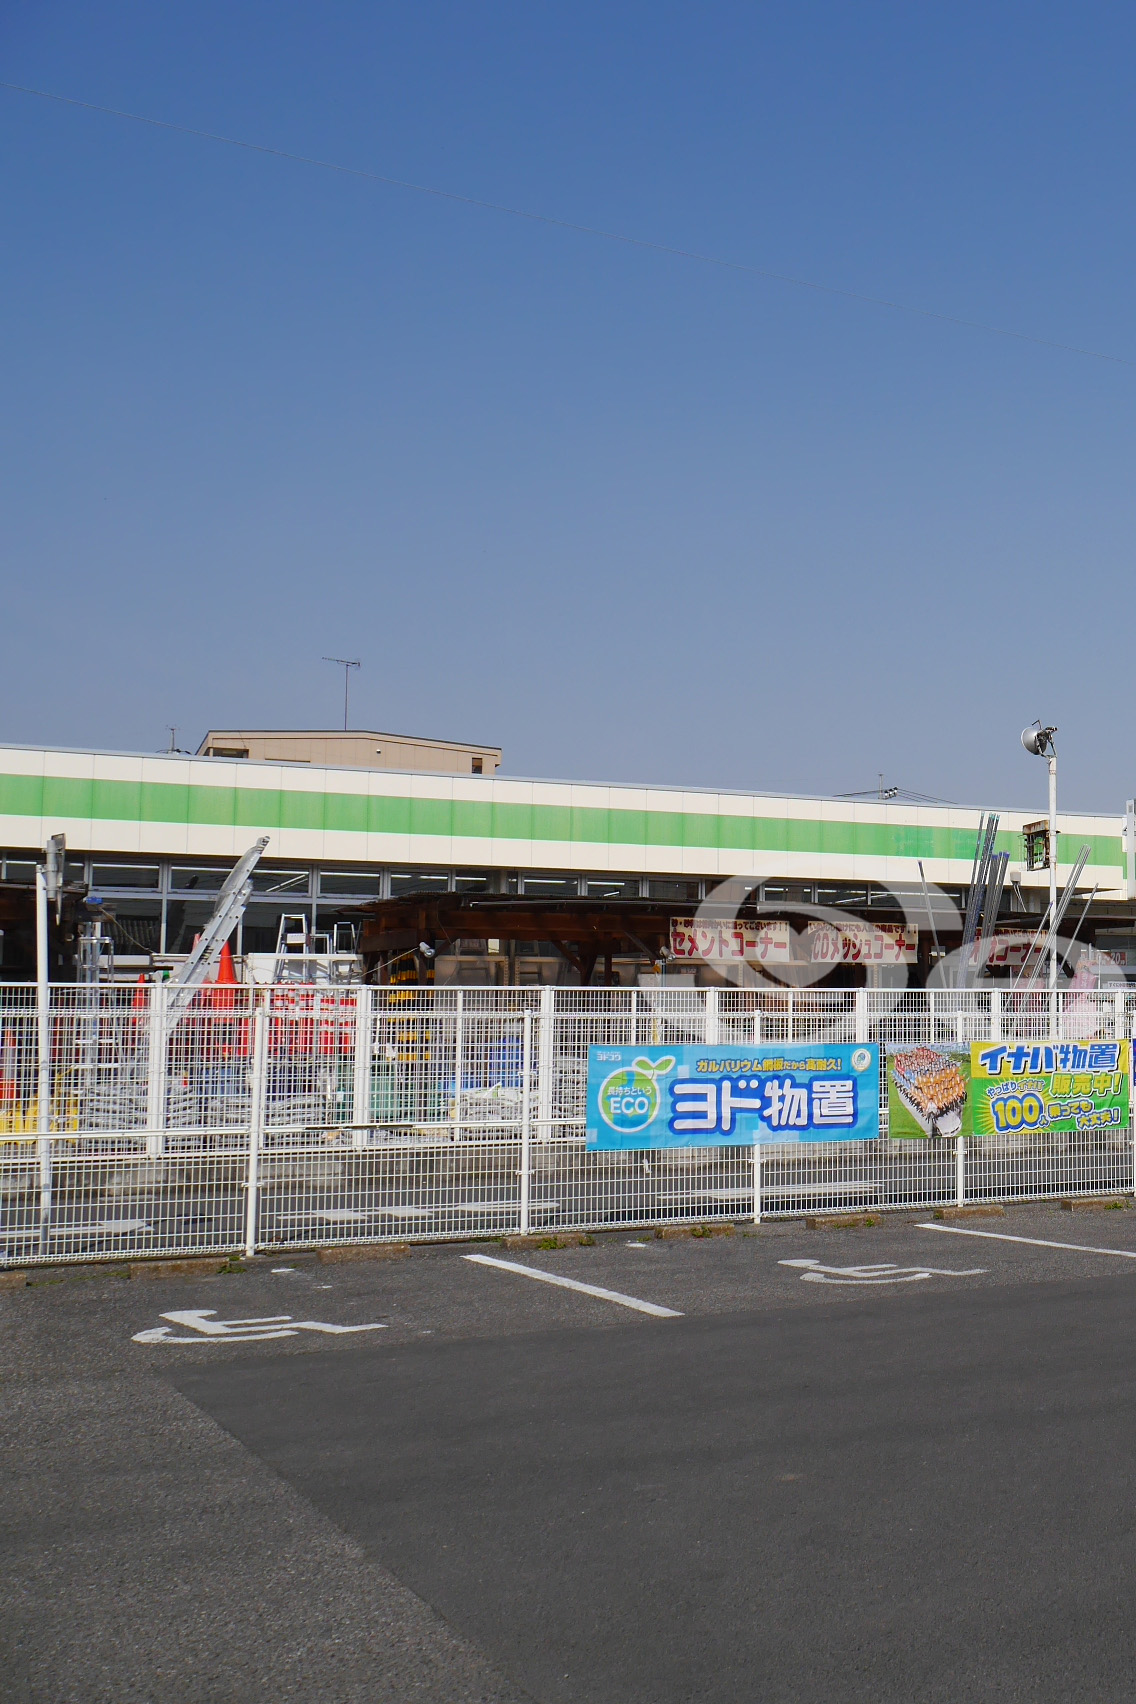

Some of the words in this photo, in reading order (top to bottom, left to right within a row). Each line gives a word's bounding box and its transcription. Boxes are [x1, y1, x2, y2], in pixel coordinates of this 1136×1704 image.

[671, 927, 787, 960] セメントコーナー
[812, 932, 916, 961] CDメッシュコーナー
[697, 1058, 842, 1073] ガルバリウム鋼板だから高耐久！
[981, 1043, 1119, 1073] イナバ物置
[607, 1086, 652, 1095] 長持ちという
[987, 1079, 1046, 1097] やっぱりイナバ
[1052, 1072, 1122, 1096] 販売中！
[610, 1097, 649, 1114] ECO
[673, 1079, 854, 1131] ヨド物置
[1049, 1100, 1093, 1118] 乗っても
[1077, 1108, 1121, 1128] 大丈夫！
